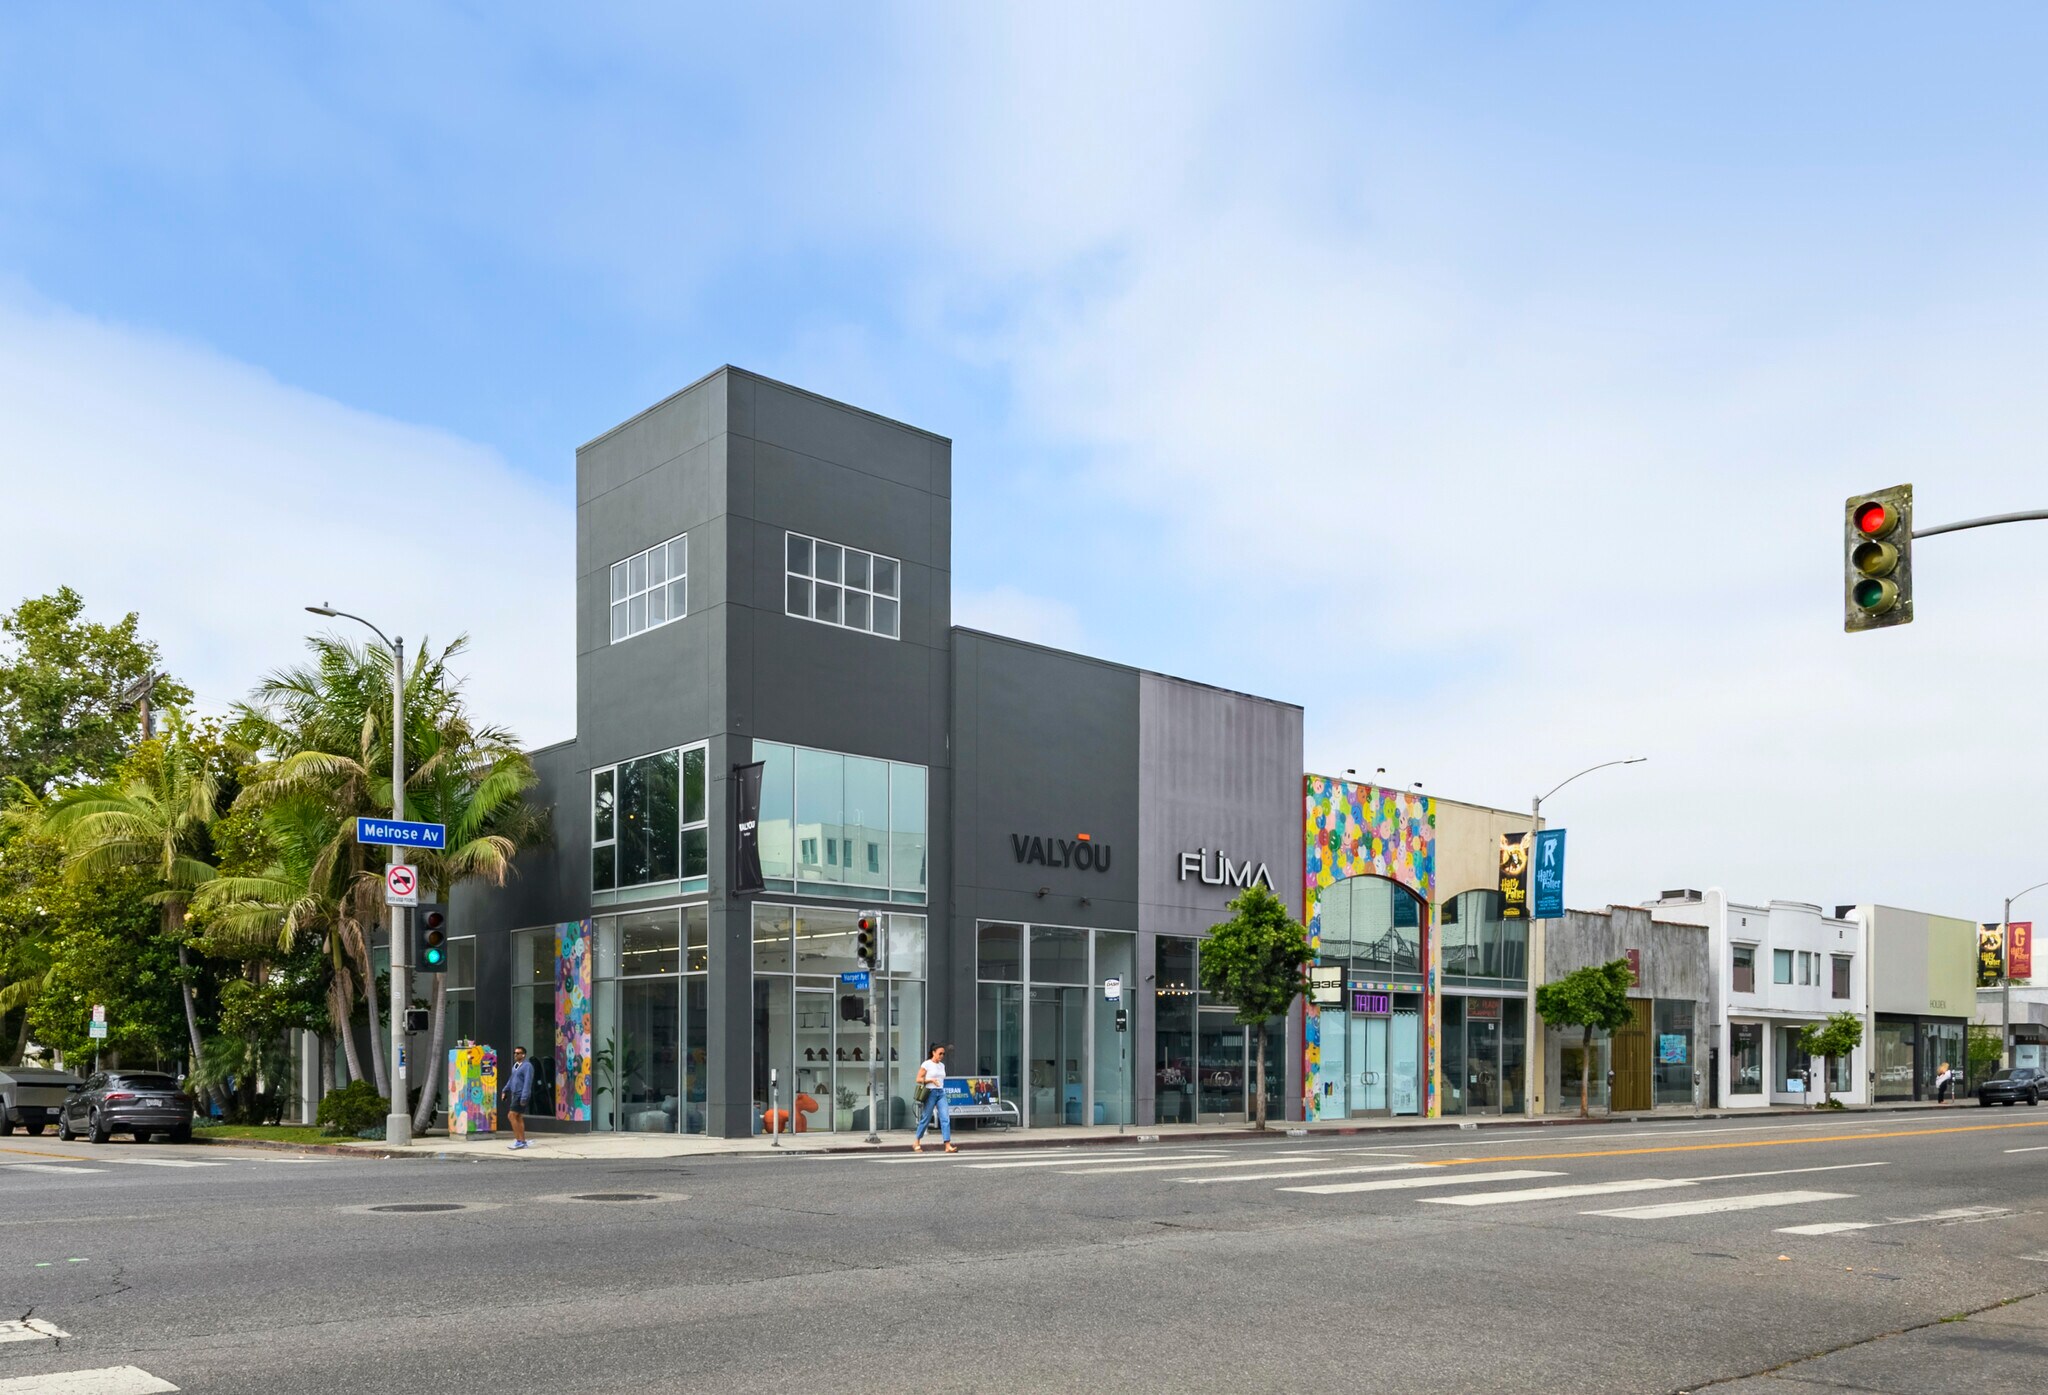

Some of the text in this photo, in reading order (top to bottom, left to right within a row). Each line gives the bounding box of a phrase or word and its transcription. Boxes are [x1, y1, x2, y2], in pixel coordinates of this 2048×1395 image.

[365, 823, 439, 842] Melrose Av
[1544, 839, 1557, 867] R
[1537, 869, 1554, 882] Harry
[1501, 878, 1519, 892] Harry
[1542, 879, 1560, 890] Potter
[1506, 888, 1525, 900] Potter
[2015, 928, 2025, 946] G
[1981, 952, 1996, 961] Harry
[1355, 995, 1388, 1013] TATTOO
